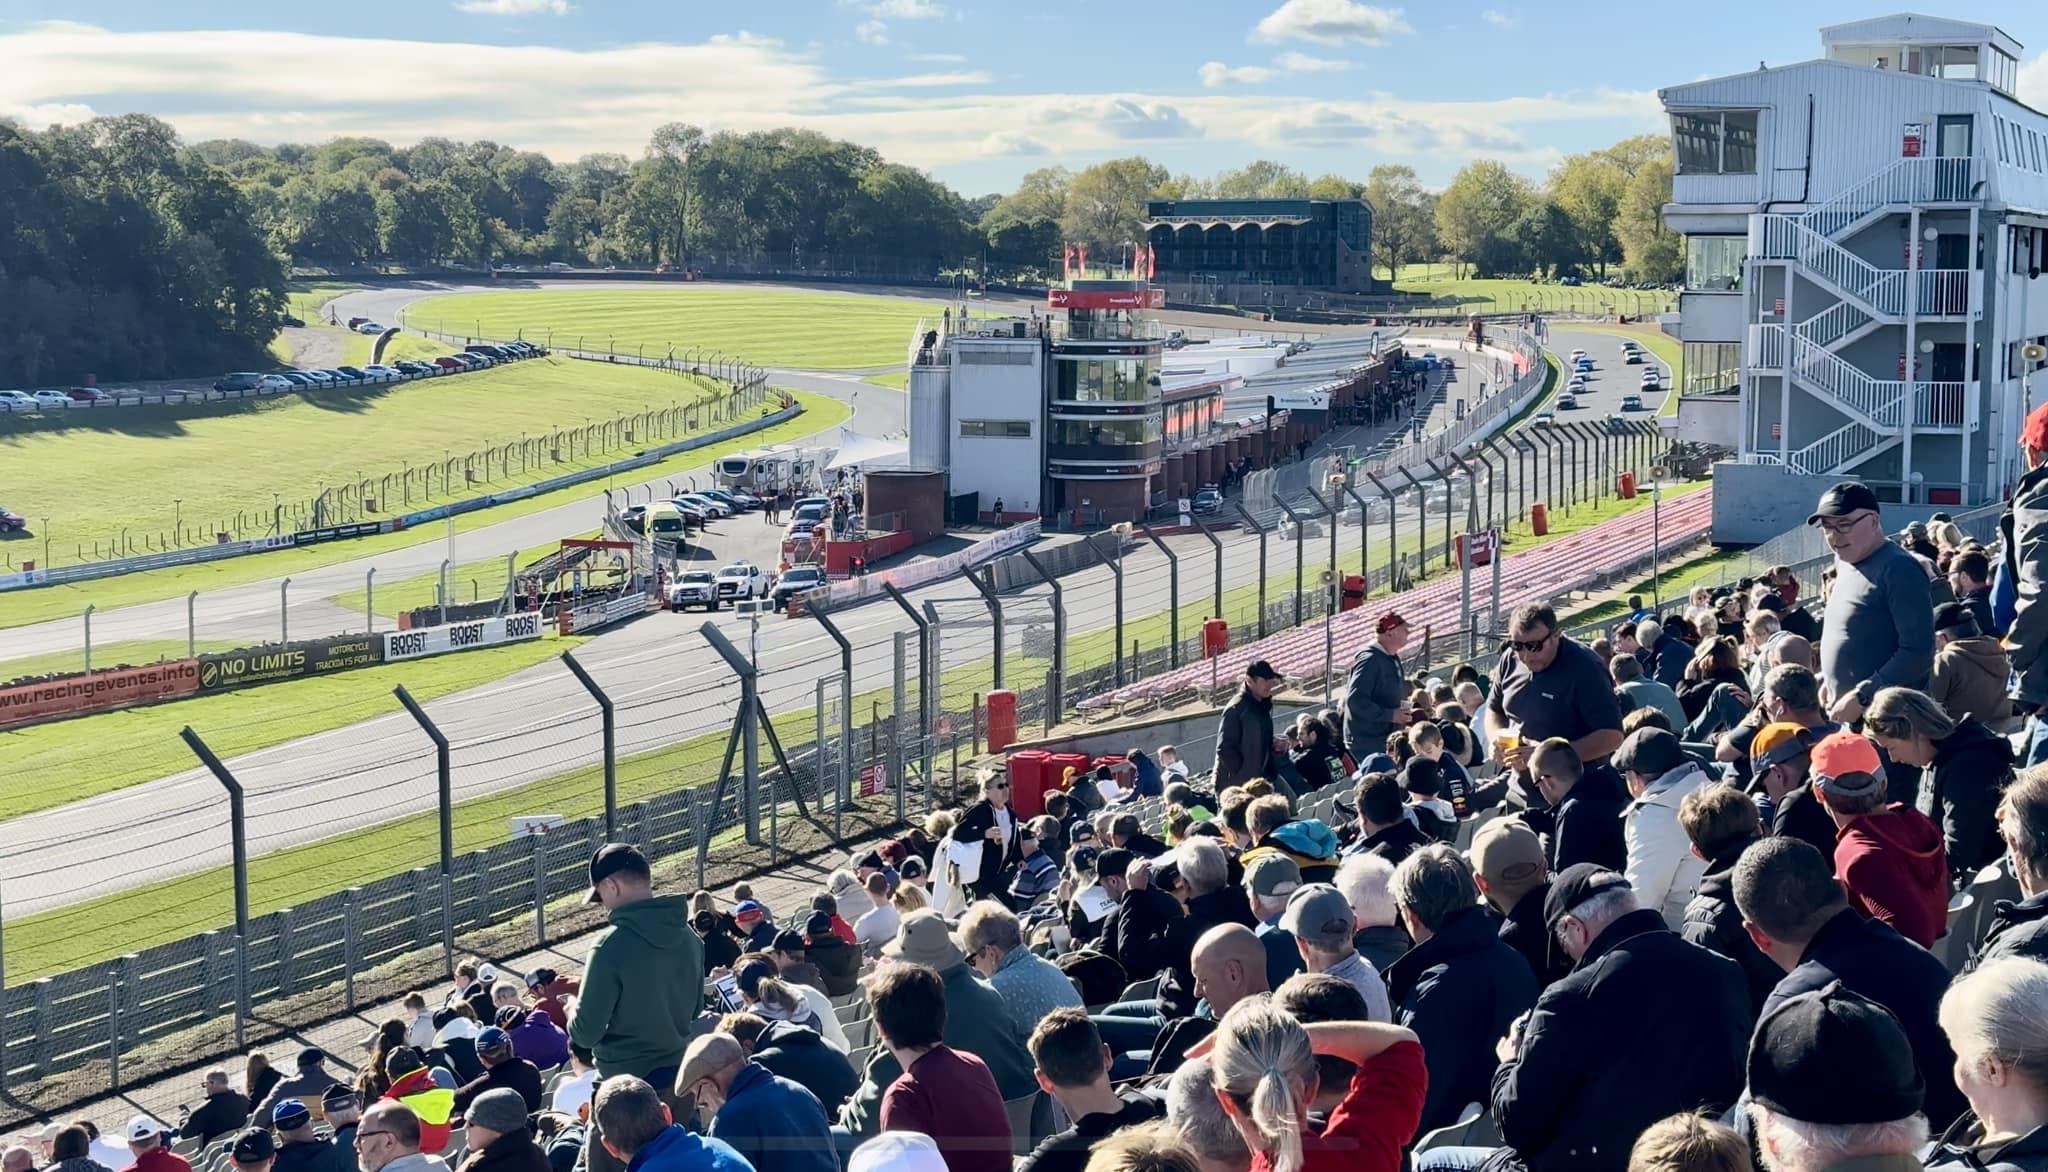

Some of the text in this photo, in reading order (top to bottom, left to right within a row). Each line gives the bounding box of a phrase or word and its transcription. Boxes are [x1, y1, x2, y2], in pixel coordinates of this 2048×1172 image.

[450, 623, 485, 642] BOOST
[506, 615, 539, 635] BOOST
[328, 641, 369, 655] MOTORCYCLE
[391, 632, 428, 652] BOOST
[221, 650, 305, 676] NO LIMITS
[315, 657, 353, 671] TRACKDAYS
[354, 654, 368, 664] FOR
